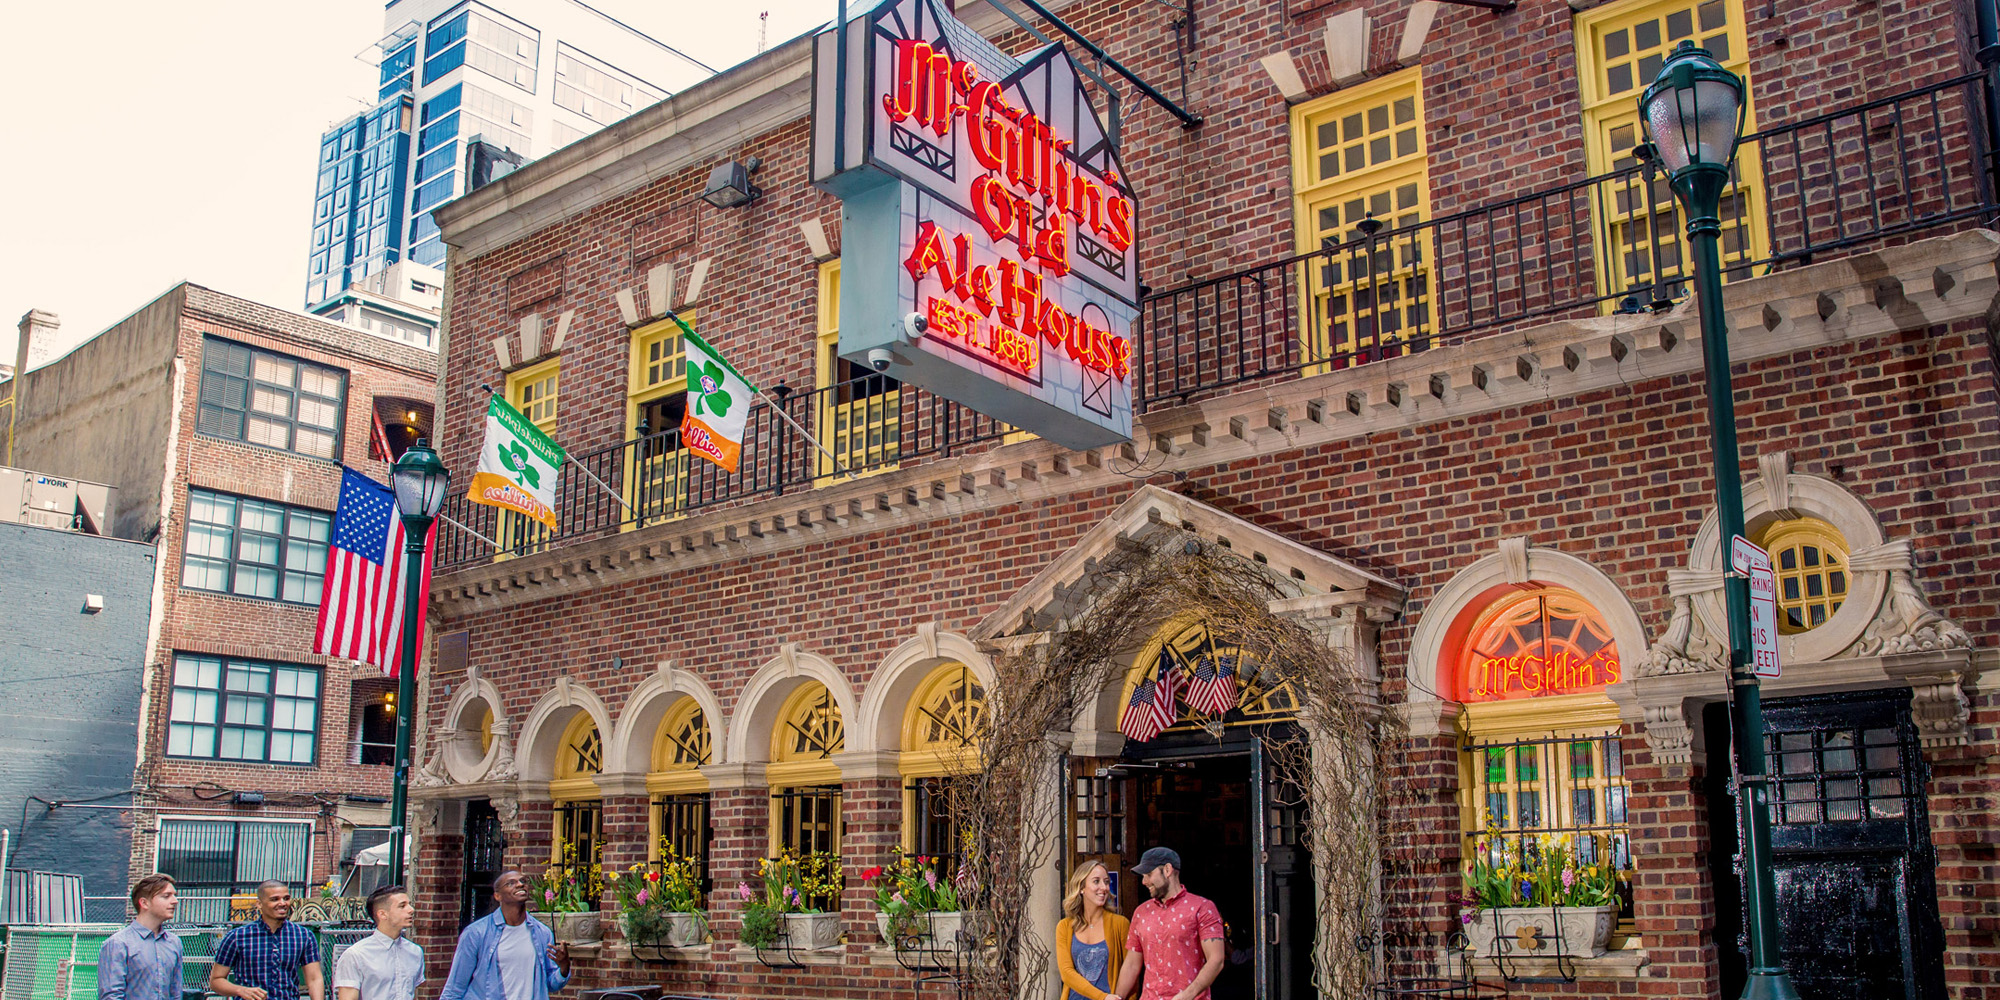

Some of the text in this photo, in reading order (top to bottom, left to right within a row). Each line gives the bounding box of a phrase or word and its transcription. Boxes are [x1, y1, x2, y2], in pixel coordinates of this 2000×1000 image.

[882, 38, 1135, 253] McGillin's
[969, 173, 1071, 278] Old
[46, 478, 68, 488] YORK
[1751, 577, 1772, 593] RKING
[1752, 605, 1759, 622] N
[1752, 627, 1767, 645] HIS
[1755, 649, 1776, 667] EET
[1477, 651, 1618, 696] McGillin's
